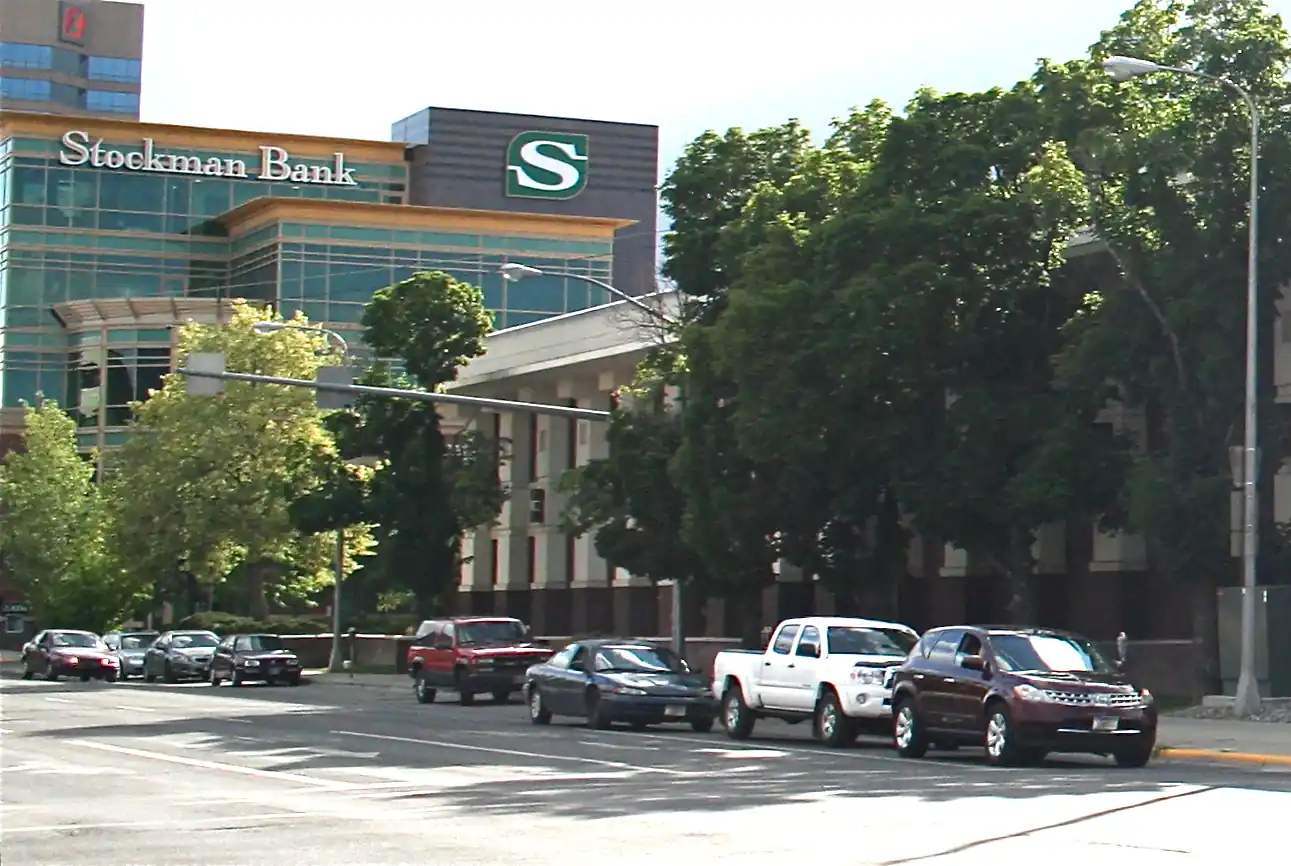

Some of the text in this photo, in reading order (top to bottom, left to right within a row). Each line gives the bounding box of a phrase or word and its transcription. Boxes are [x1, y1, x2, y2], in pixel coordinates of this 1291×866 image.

[60, 130, 358, 185] Stockman Bank
[507, 140, 588, 191] S
